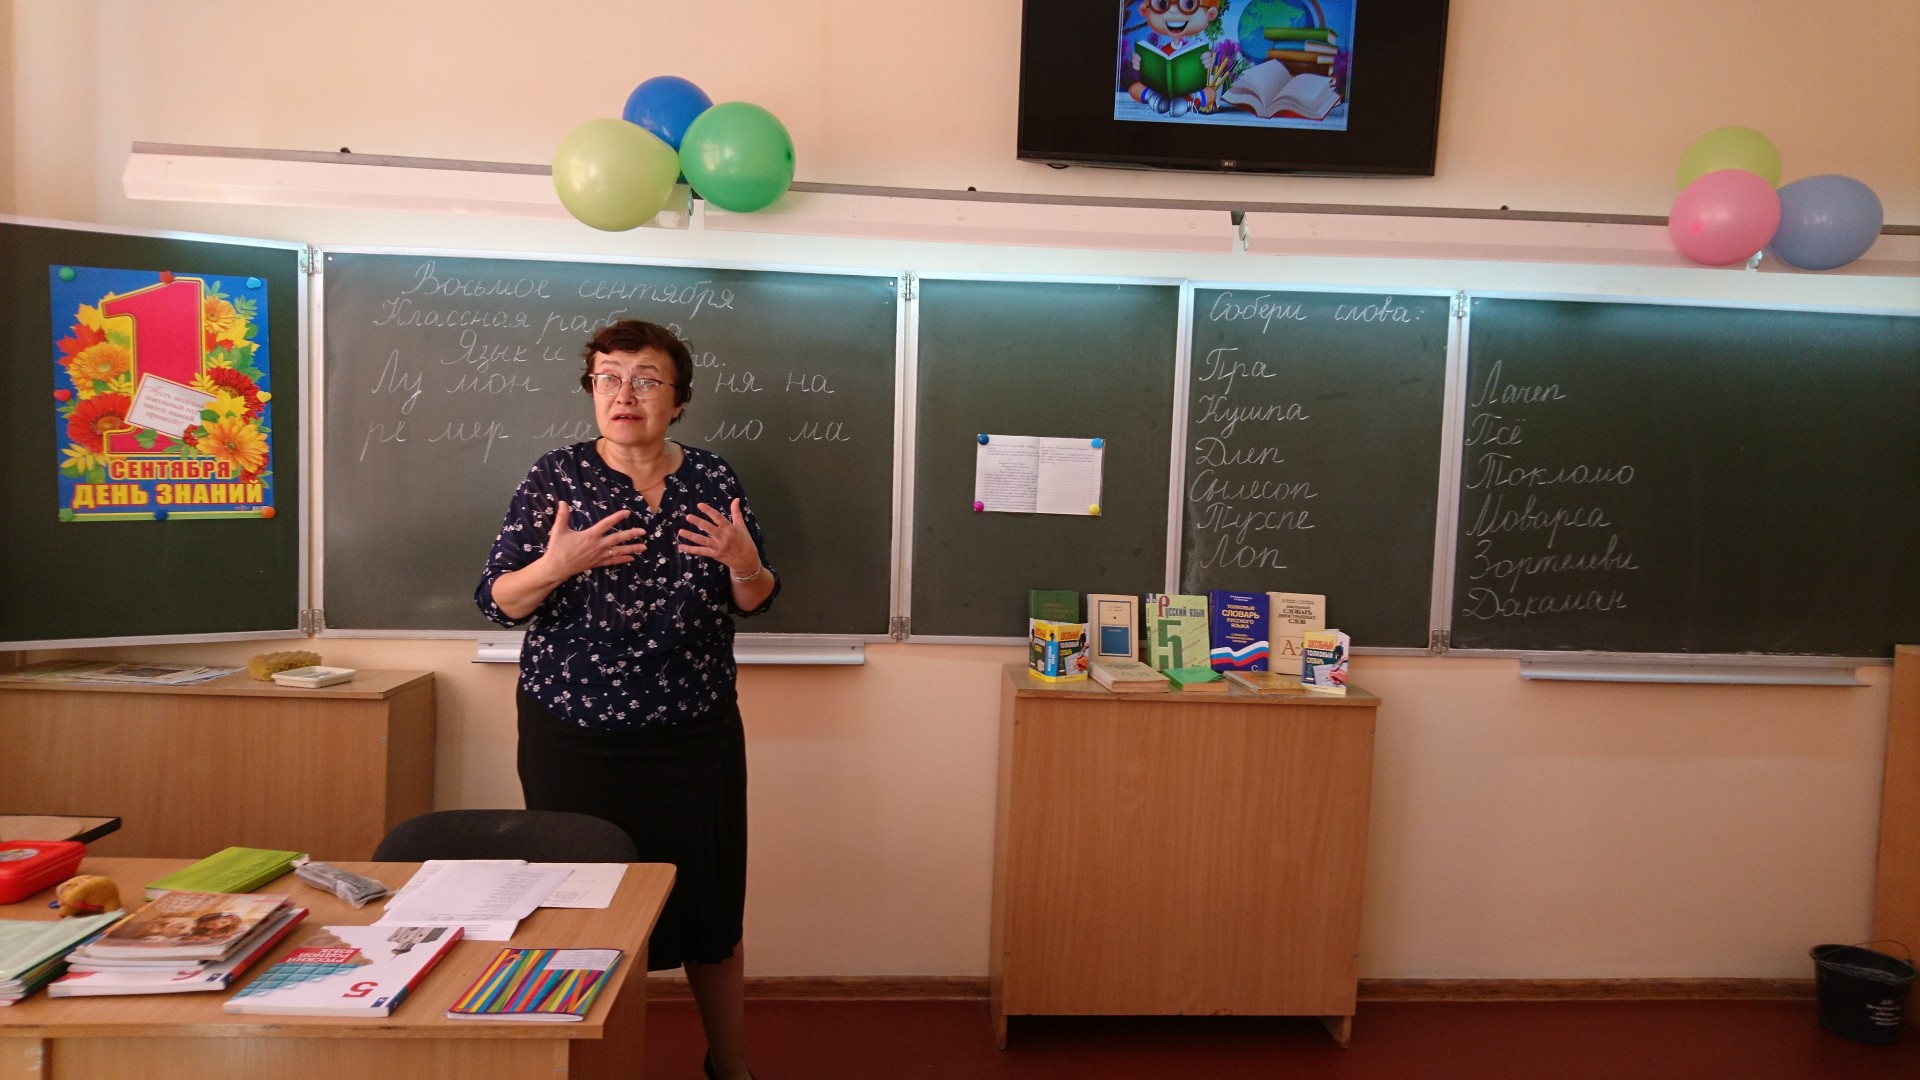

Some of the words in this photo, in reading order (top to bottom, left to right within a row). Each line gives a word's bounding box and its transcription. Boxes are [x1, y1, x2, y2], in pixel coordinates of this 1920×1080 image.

[402, 260, 550, 299] Восьмое
[578, 280, 735, 319] сентября
[372, 297, 530, 329] Классная
[1209, 291, 1308, 334] Собери
[1334, 296, 1424, 323] слова:
[100, 276, 205, 457] 1
[441, 329, 528, 373] Язык
[543, 345, 567, 361] и
[371, 349, 422, 415] Лу
[446, 373, 541, 394] мон
[715, 371, 764, 393] ня
[785, 371, 836, 394] на
[1471, 360, 1566, 407] Лачеп
[1196, 394, 1310, 438] Кушпа
[1465, 413, 1526, 446] Псё
[360, 420, 408, 462] ре
[428, 420, 511, 463] мер
[705, 419, 764, 442] мо
[789, 420, 851, 442] ма
[110, 460, 231, 480] СЕНТЯБРЯ
[1189, 469, 1318, 501] Сылесоп
[1466, 452, 1634, 489] Токломо
[72, 484, 149, 508] ДЕНЬ
[156, 480, 262, 504] ЗНАНИЙ
[1465, 493, 1610, 549] Моварса
[1200, 534, 1287, 568] Лоп
[1470, 534, 1640, 593] Зортелеви
[1221, 609, 1260, 619] СЛОВАРЬ
[1157, 620, 1184, 669] 5
[341, 981, 380, 998] 5
